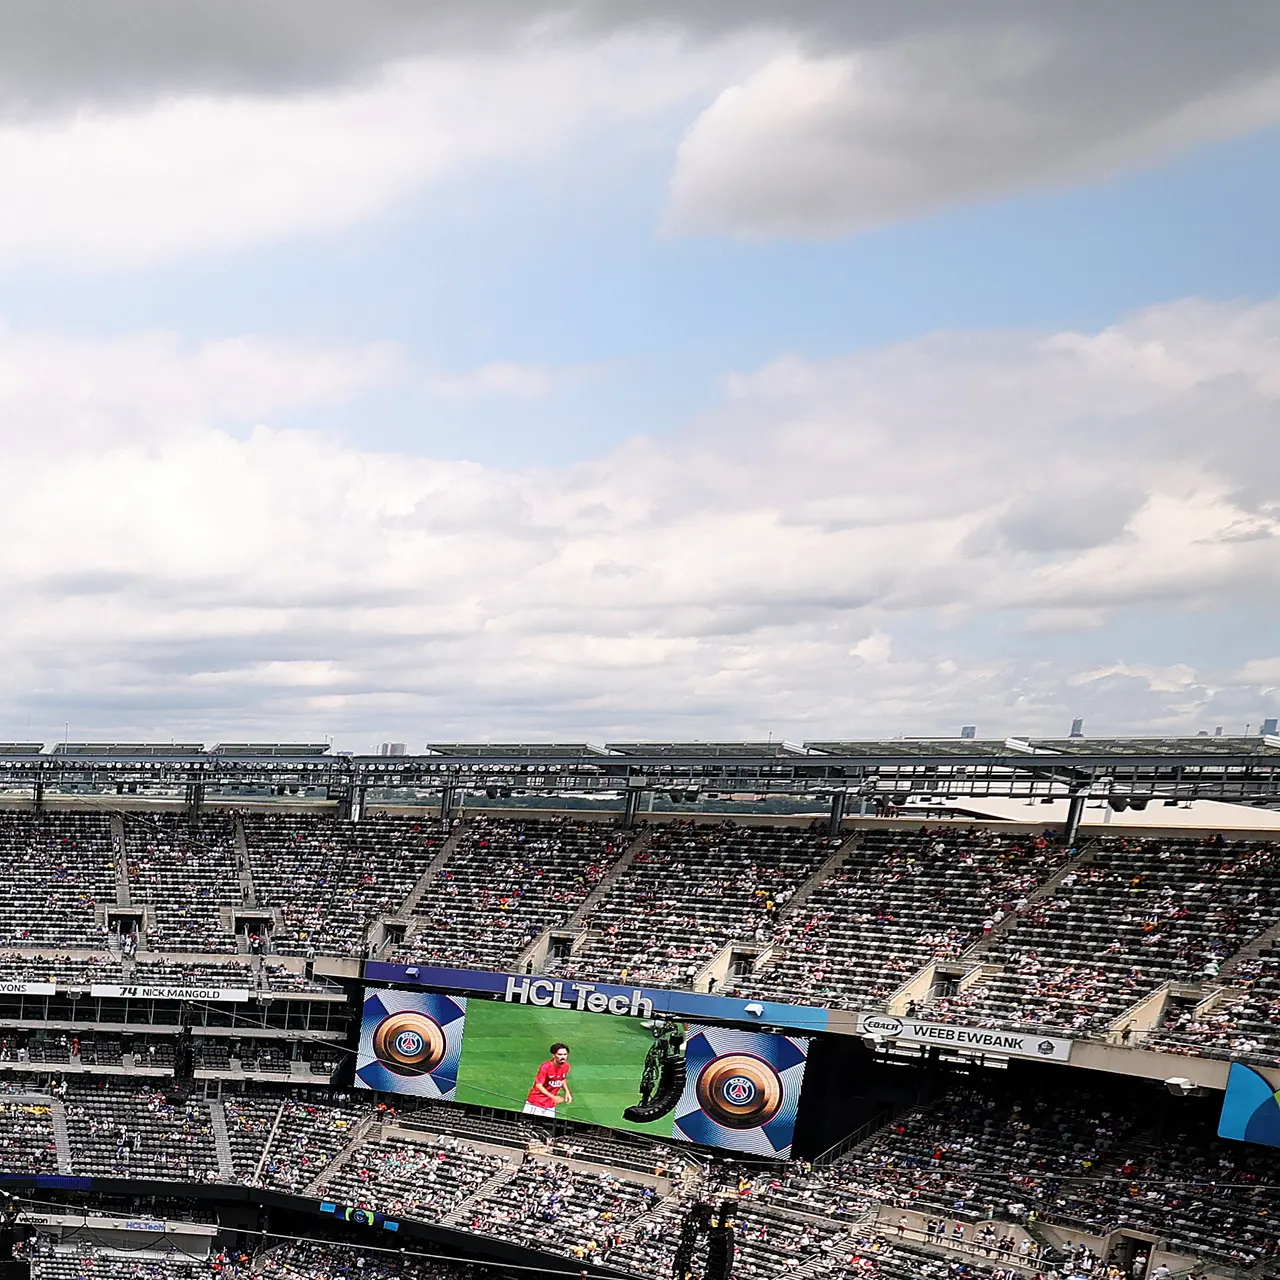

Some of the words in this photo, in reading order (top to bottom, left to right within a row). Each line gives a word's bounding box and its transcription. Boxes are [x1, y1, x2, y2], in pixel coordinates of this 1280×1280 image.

[119, 986, 138, 997] 74
[142, 987, 167, 998] NICK
[166, 988, 220, 1000] MANGOLD
[504, 976, 654, 1019] HCLTech
[867, 1019, 899, 1032] COACH
[913, 1024, 955, 1041] WEEB
[957, 1030, 1024, 1050] EWBANK
[19, 1215, 48, 1224] verizon
